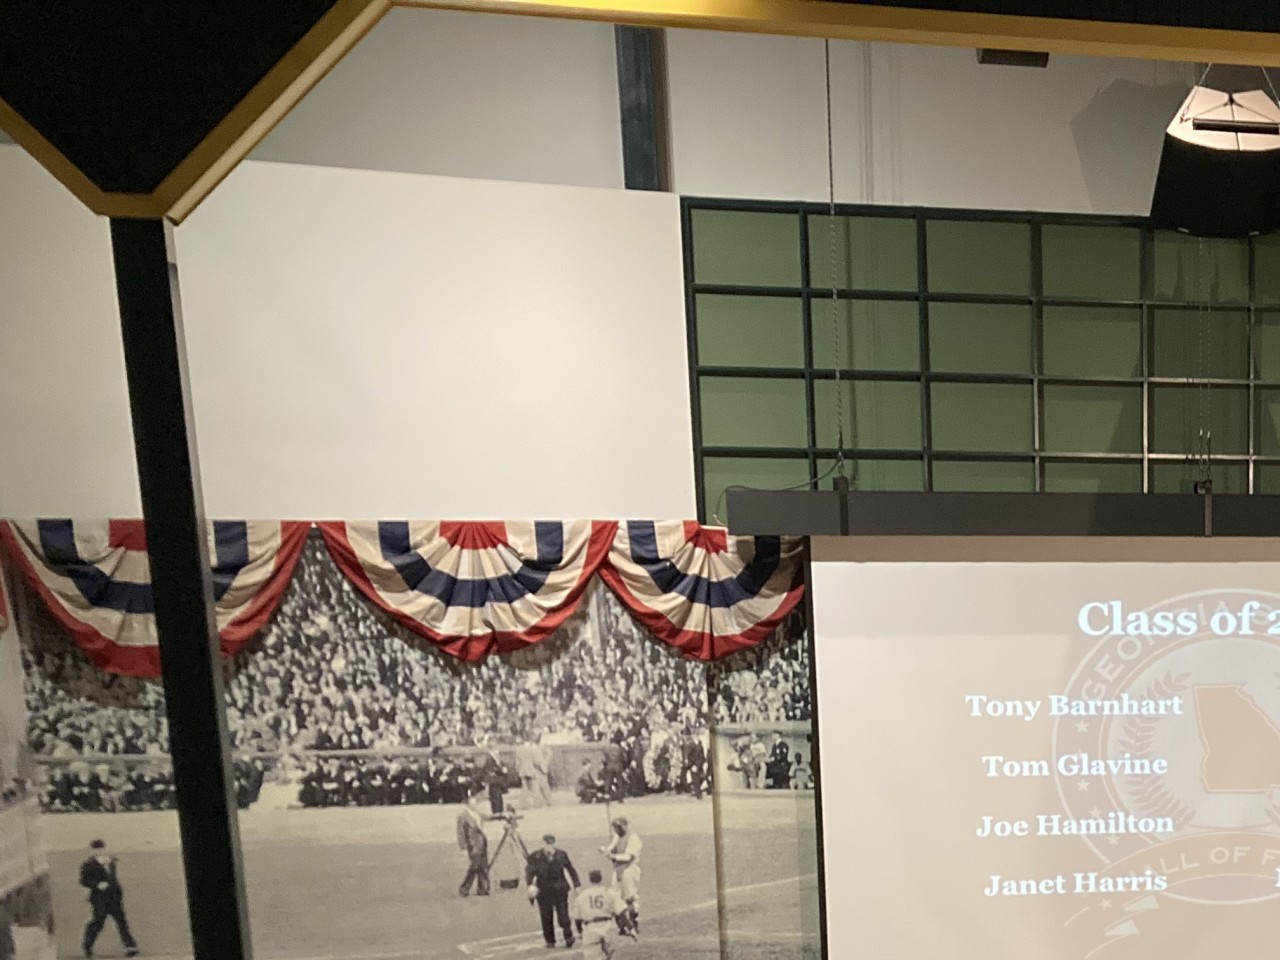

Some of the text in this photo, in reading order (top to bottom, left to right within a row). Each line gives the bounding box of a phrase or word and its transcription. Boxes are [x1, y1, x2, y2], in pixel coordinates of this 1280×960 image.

[1077, 600, 1198, 636] Class
[1210, 601, 1260, 635] of
[965, 692, 1184, 722] Tony Barnhart
[981, 753, 1169, 777] Tom Glavine
[975, 811, 1175, 837] Joe Hamilton
[1209, 845, 1252, 864] OF
[983, 869, 1168, 897] Janet Harris
